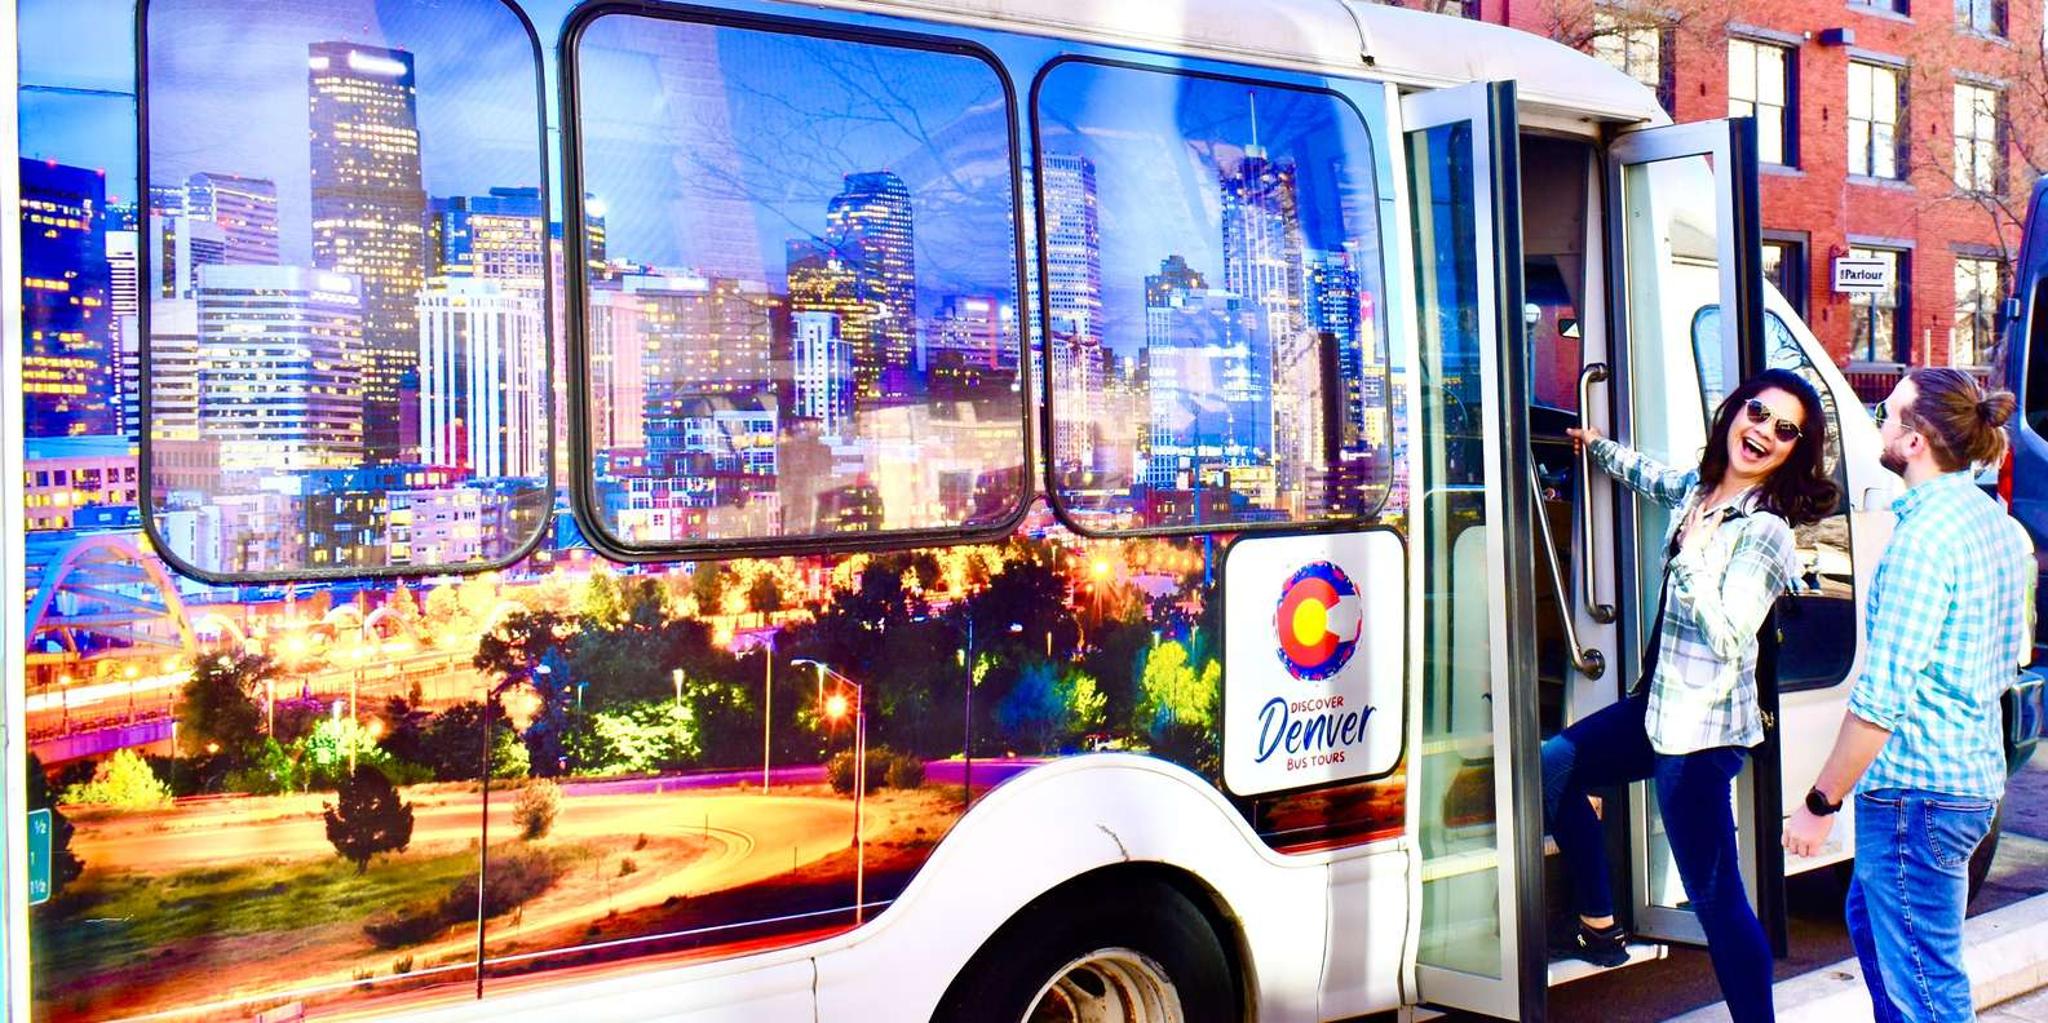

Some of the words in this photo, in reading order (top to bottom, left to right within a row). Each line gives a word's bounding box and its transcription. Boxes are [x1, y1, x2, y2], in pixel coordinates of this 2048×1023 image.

[1845, 269, 1883, 280] Parlour
[1290, 695, 1345, 714] DISCOVER
[1254, 696, 1377, 763] Denver
[1286, 754, 1308, 771] BUS
[1310, 750, 1346, 767] TOURS
